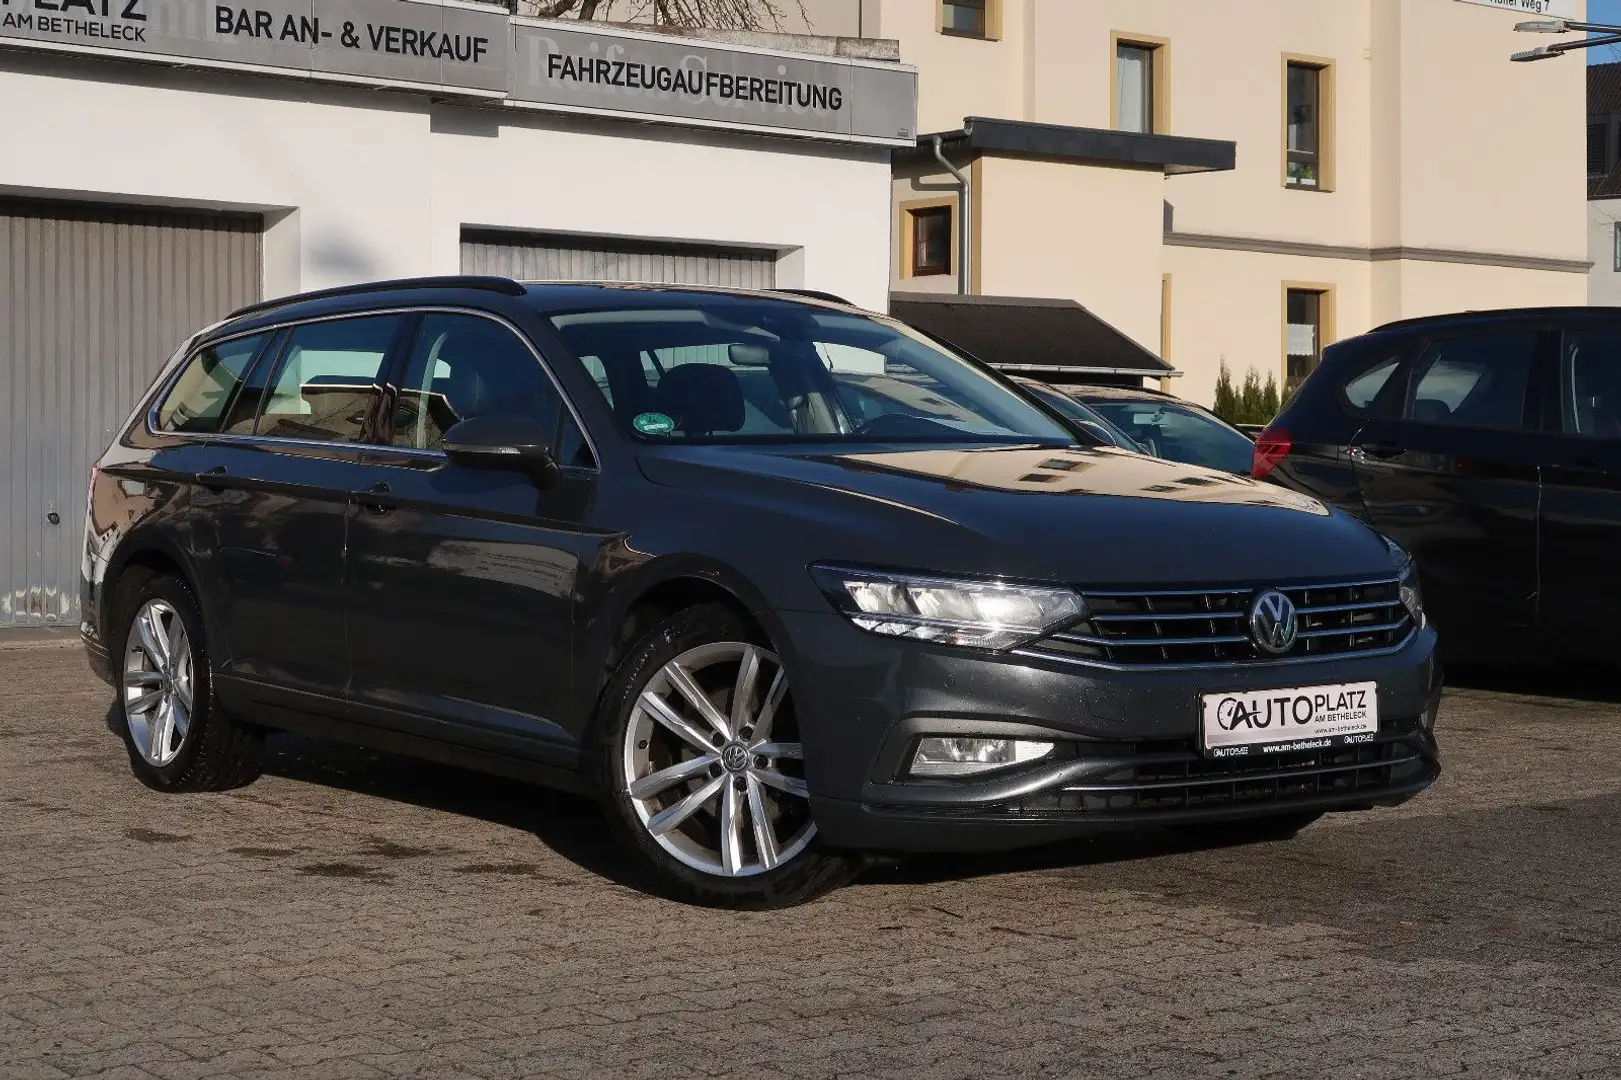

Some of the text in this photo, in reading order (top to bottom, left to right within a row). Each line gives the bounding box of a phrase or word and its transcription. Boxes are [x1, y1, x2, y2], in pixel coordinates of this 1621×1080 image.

[1521, 0, 1542, 13] Weg
[1544, 0, 1550, 11] 7
[2, 12, 33, 30] AM
[37, 16, 147, 43] BETHELECK
[215, 5, 273, 40] BAR
[279, 14, 333, 44] AN-
[340, 21, 361, 49] &
[366, 23, 489, 63] VERKAUF
[547, 53, 842, 111] FAHRZEUGAUFBEREITUNG
[1314, 711, 1367, 723] AM BETHELECK
[1262, 738, 1332, 753] www.am-betheleck.de
